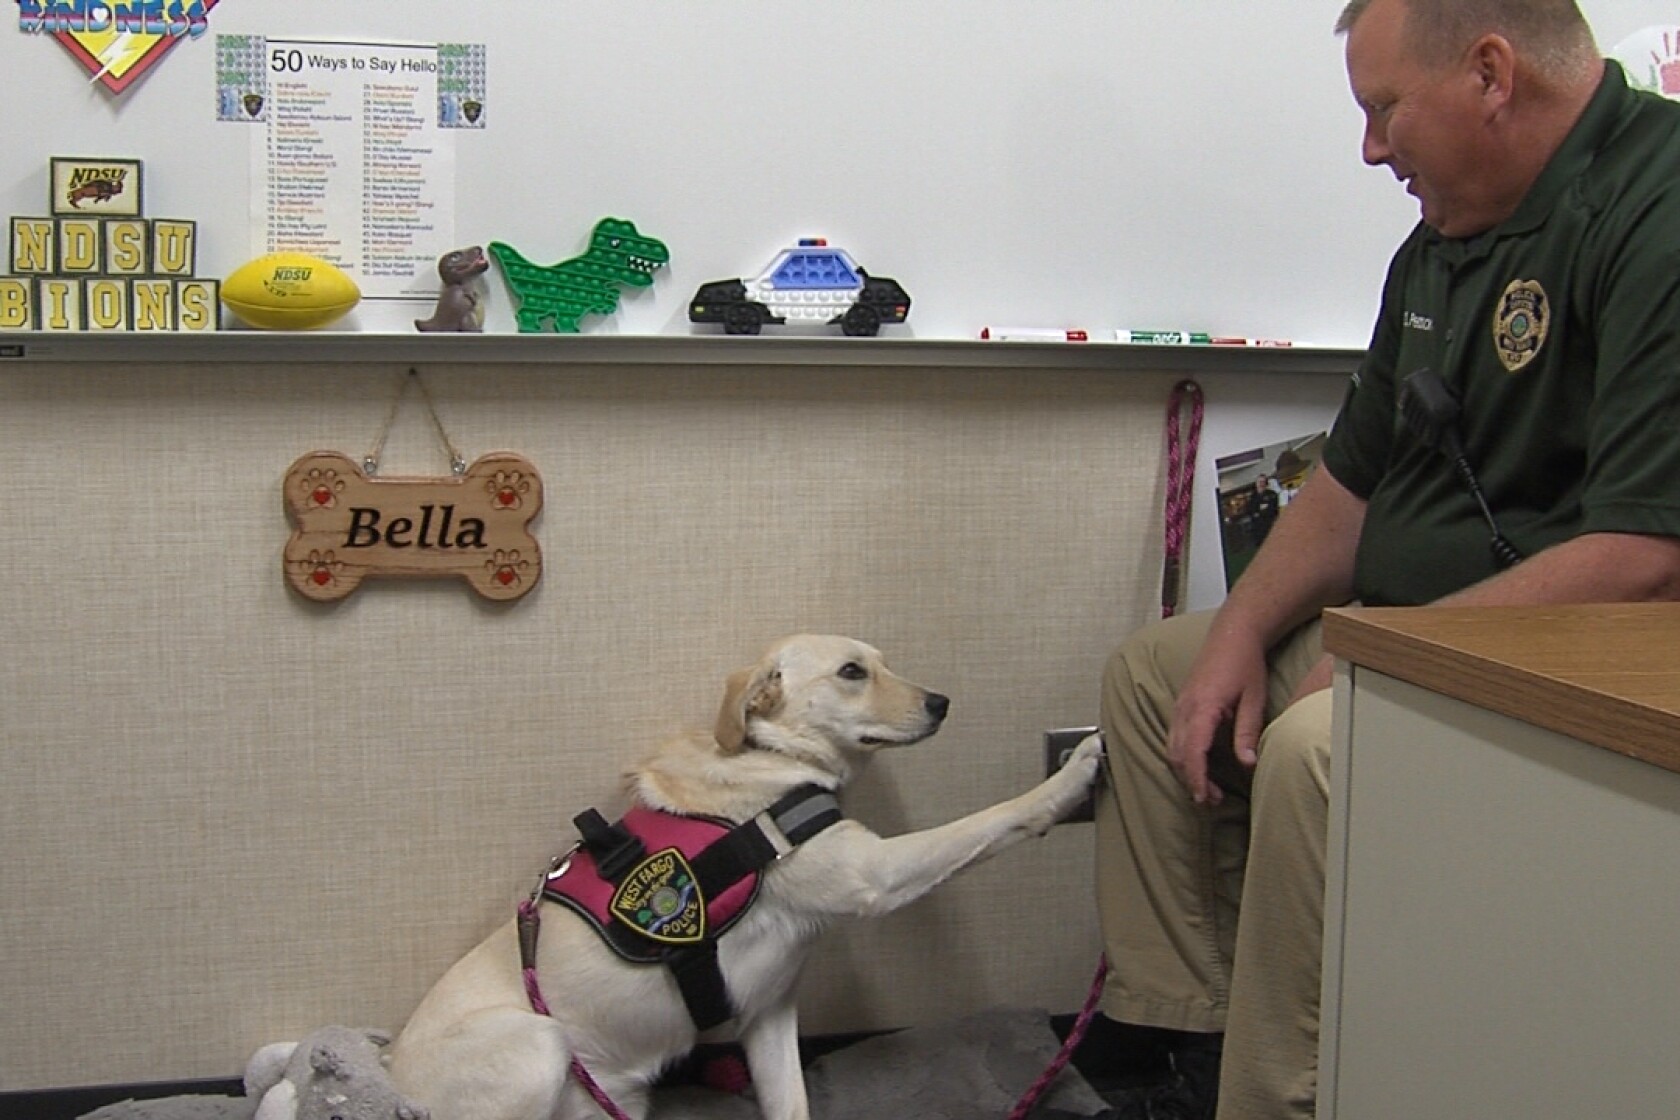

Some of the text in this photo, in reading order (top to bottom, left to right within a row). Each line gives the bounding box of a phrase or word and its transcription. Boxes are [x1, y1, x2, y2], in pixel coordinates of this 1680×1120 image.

[271, 49, 437, 73] 50 Ways to Say Hello
[68, 168, 127, 188] NDSU
[16, 223, 190, 271] NDSU
[273, 269, 312, 281] NDSU
[341, 504, 488, 548] Bella
[618, 878, 644, 910] WEST
[638, 855, 675, 884] FARGO
[662, 902, 698, 936] POLICE
